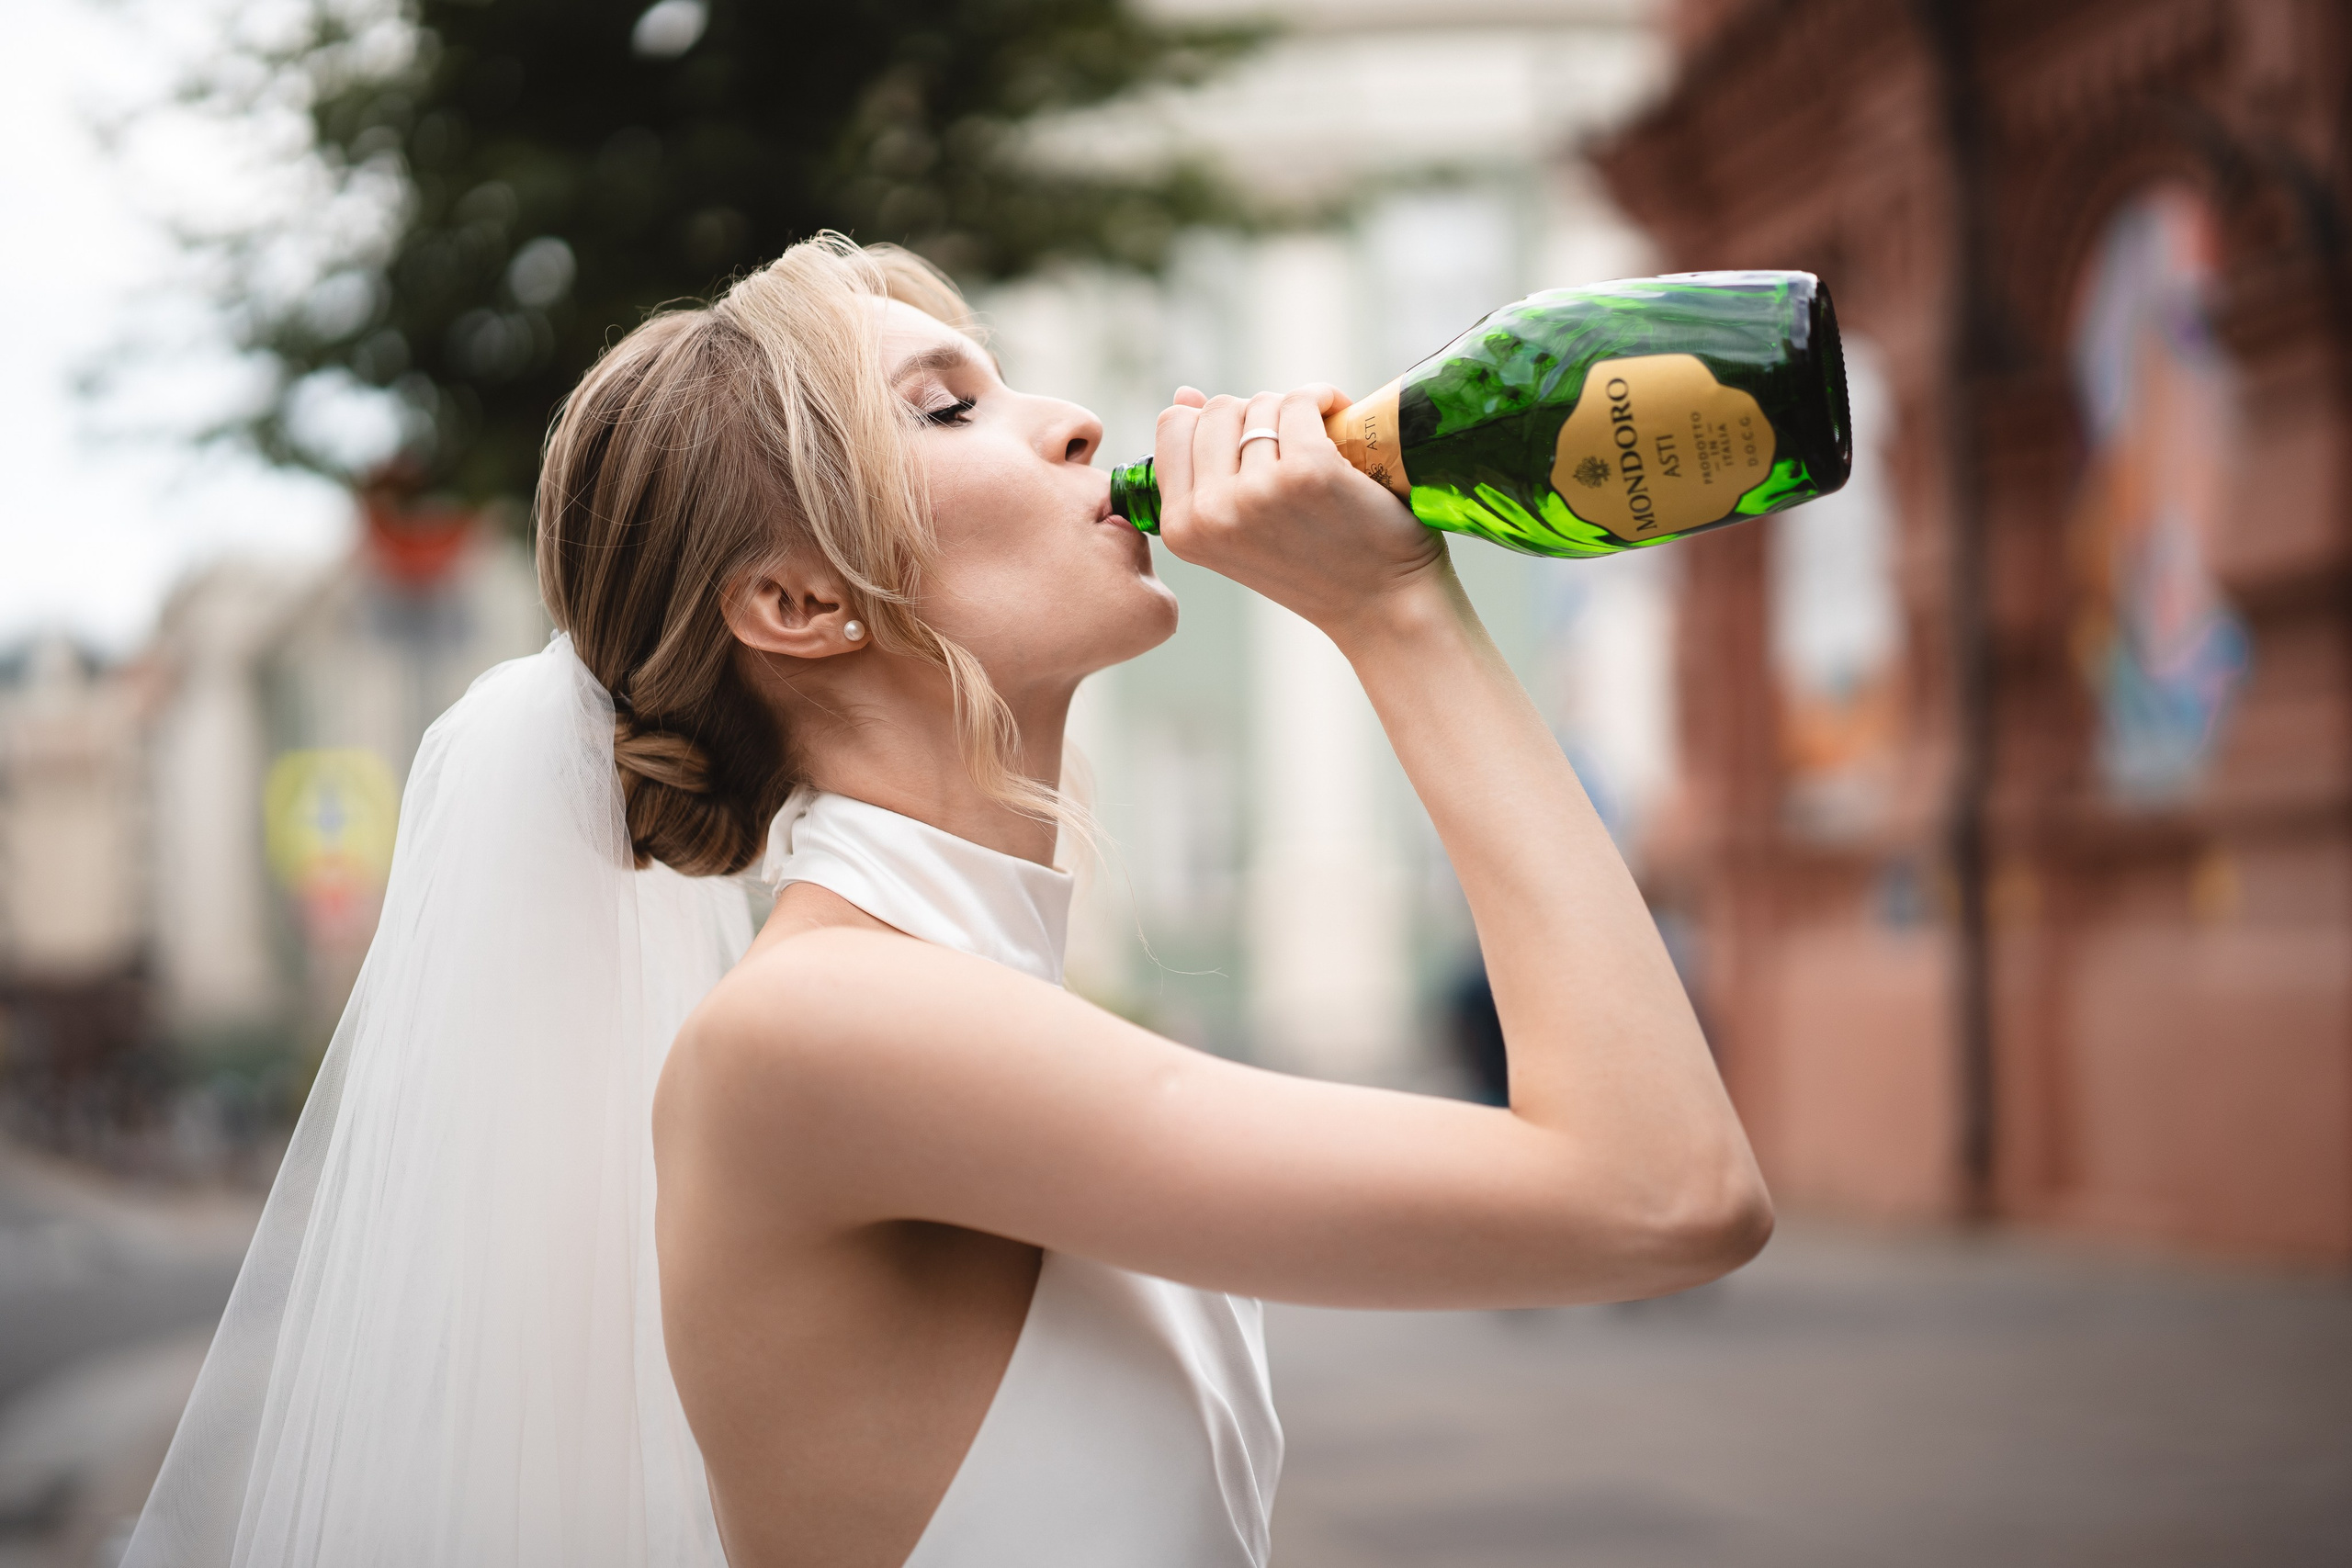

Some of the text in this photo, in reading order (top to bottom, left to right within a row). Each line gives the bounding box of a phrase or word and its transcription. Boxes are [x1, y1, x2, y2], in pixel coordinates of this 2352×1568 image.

[1364, 415, 1378, 451] ASTI
[1606, 378, 1657, 532] MONDORO
[1690, 412, 1713, 484] PRODOTTO
[1710, 441, 1720, 456] IN
[1718, 423, 1734, 467] ITALIA
[1656, 434, 1681, 478] ASTI
